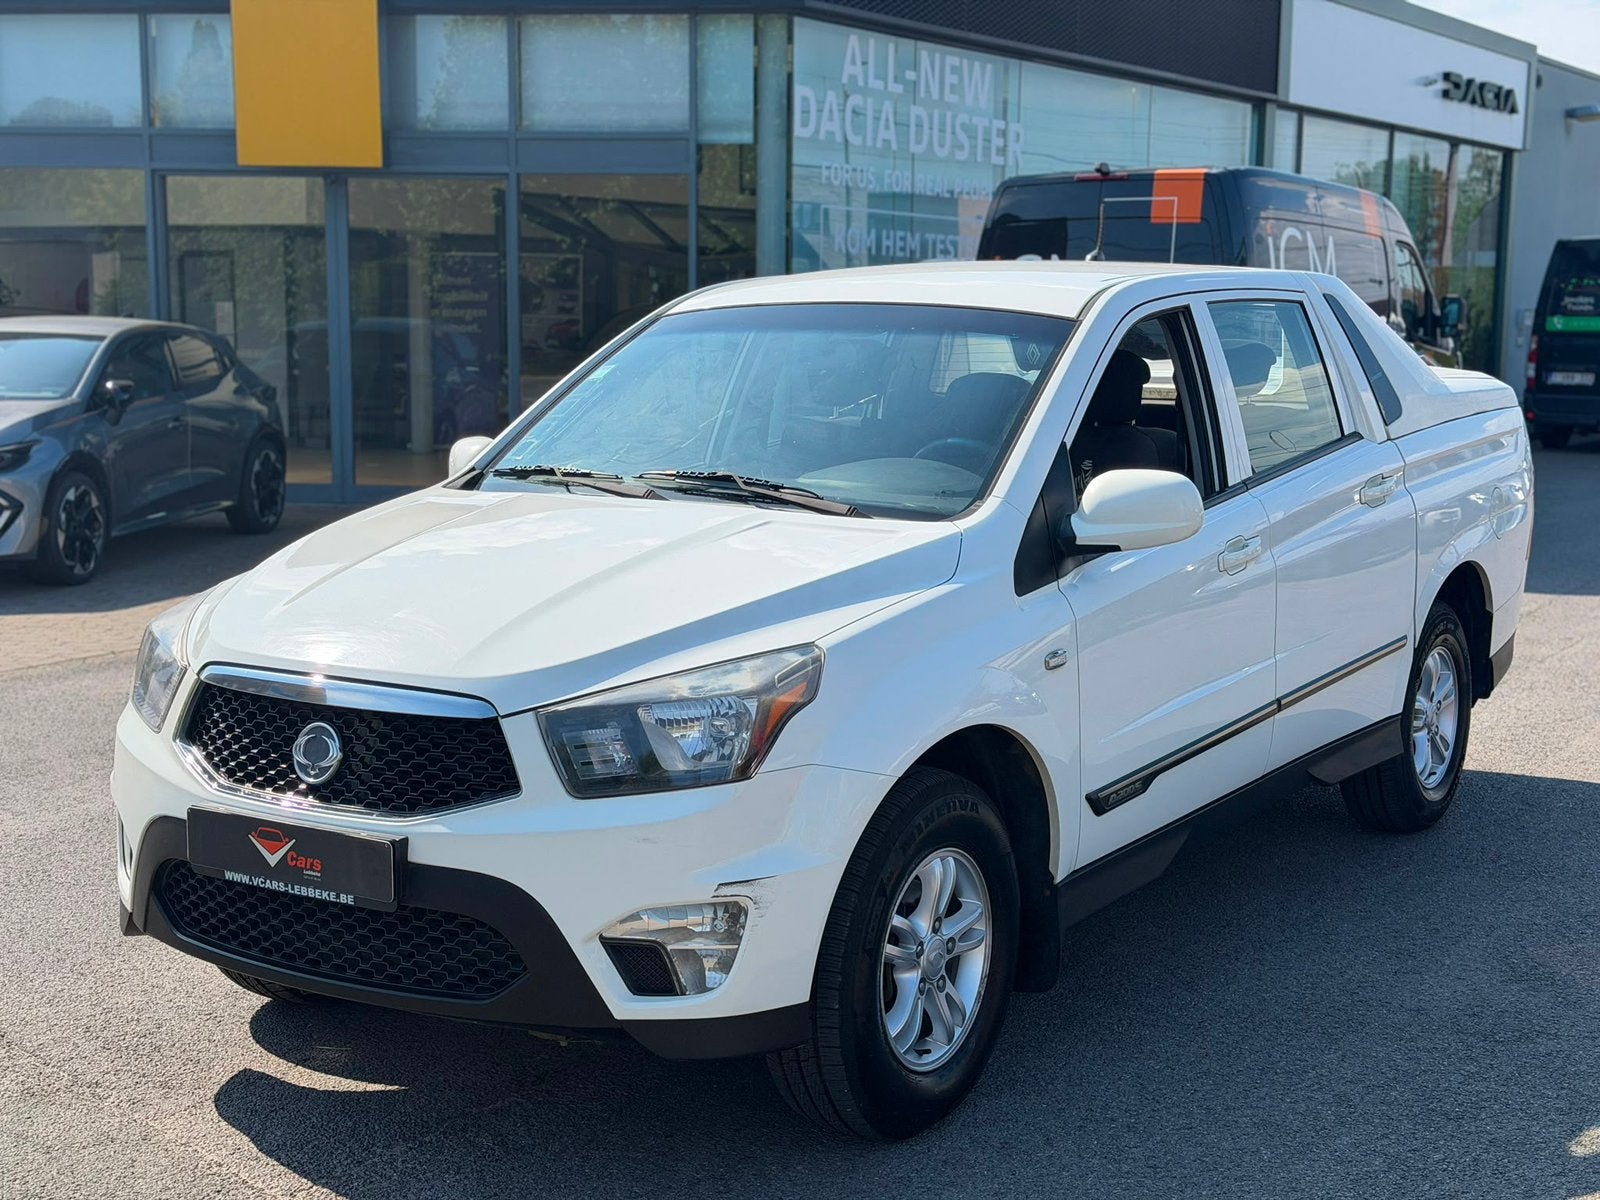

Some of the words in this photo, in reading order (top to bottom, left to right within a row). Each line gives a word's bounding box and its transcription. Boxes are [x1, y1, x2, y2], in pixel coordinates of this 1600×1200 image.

[841, 34, 993, 110] ALL-NEW
[1441, 70, 1519, 115] DACIA
[793, 85, 897, 150] DACIA
[908, 104, 1025, 167] DUSTER
[821, 163, 853, 187] FOR
[883, 170, 912, 192] FOR
[881, 227, 921, 258] HEM
[287, 851, 322, 871] Cars
[224, 869, 355, 905] WWW.VCARS-LEBBEKE.BE
